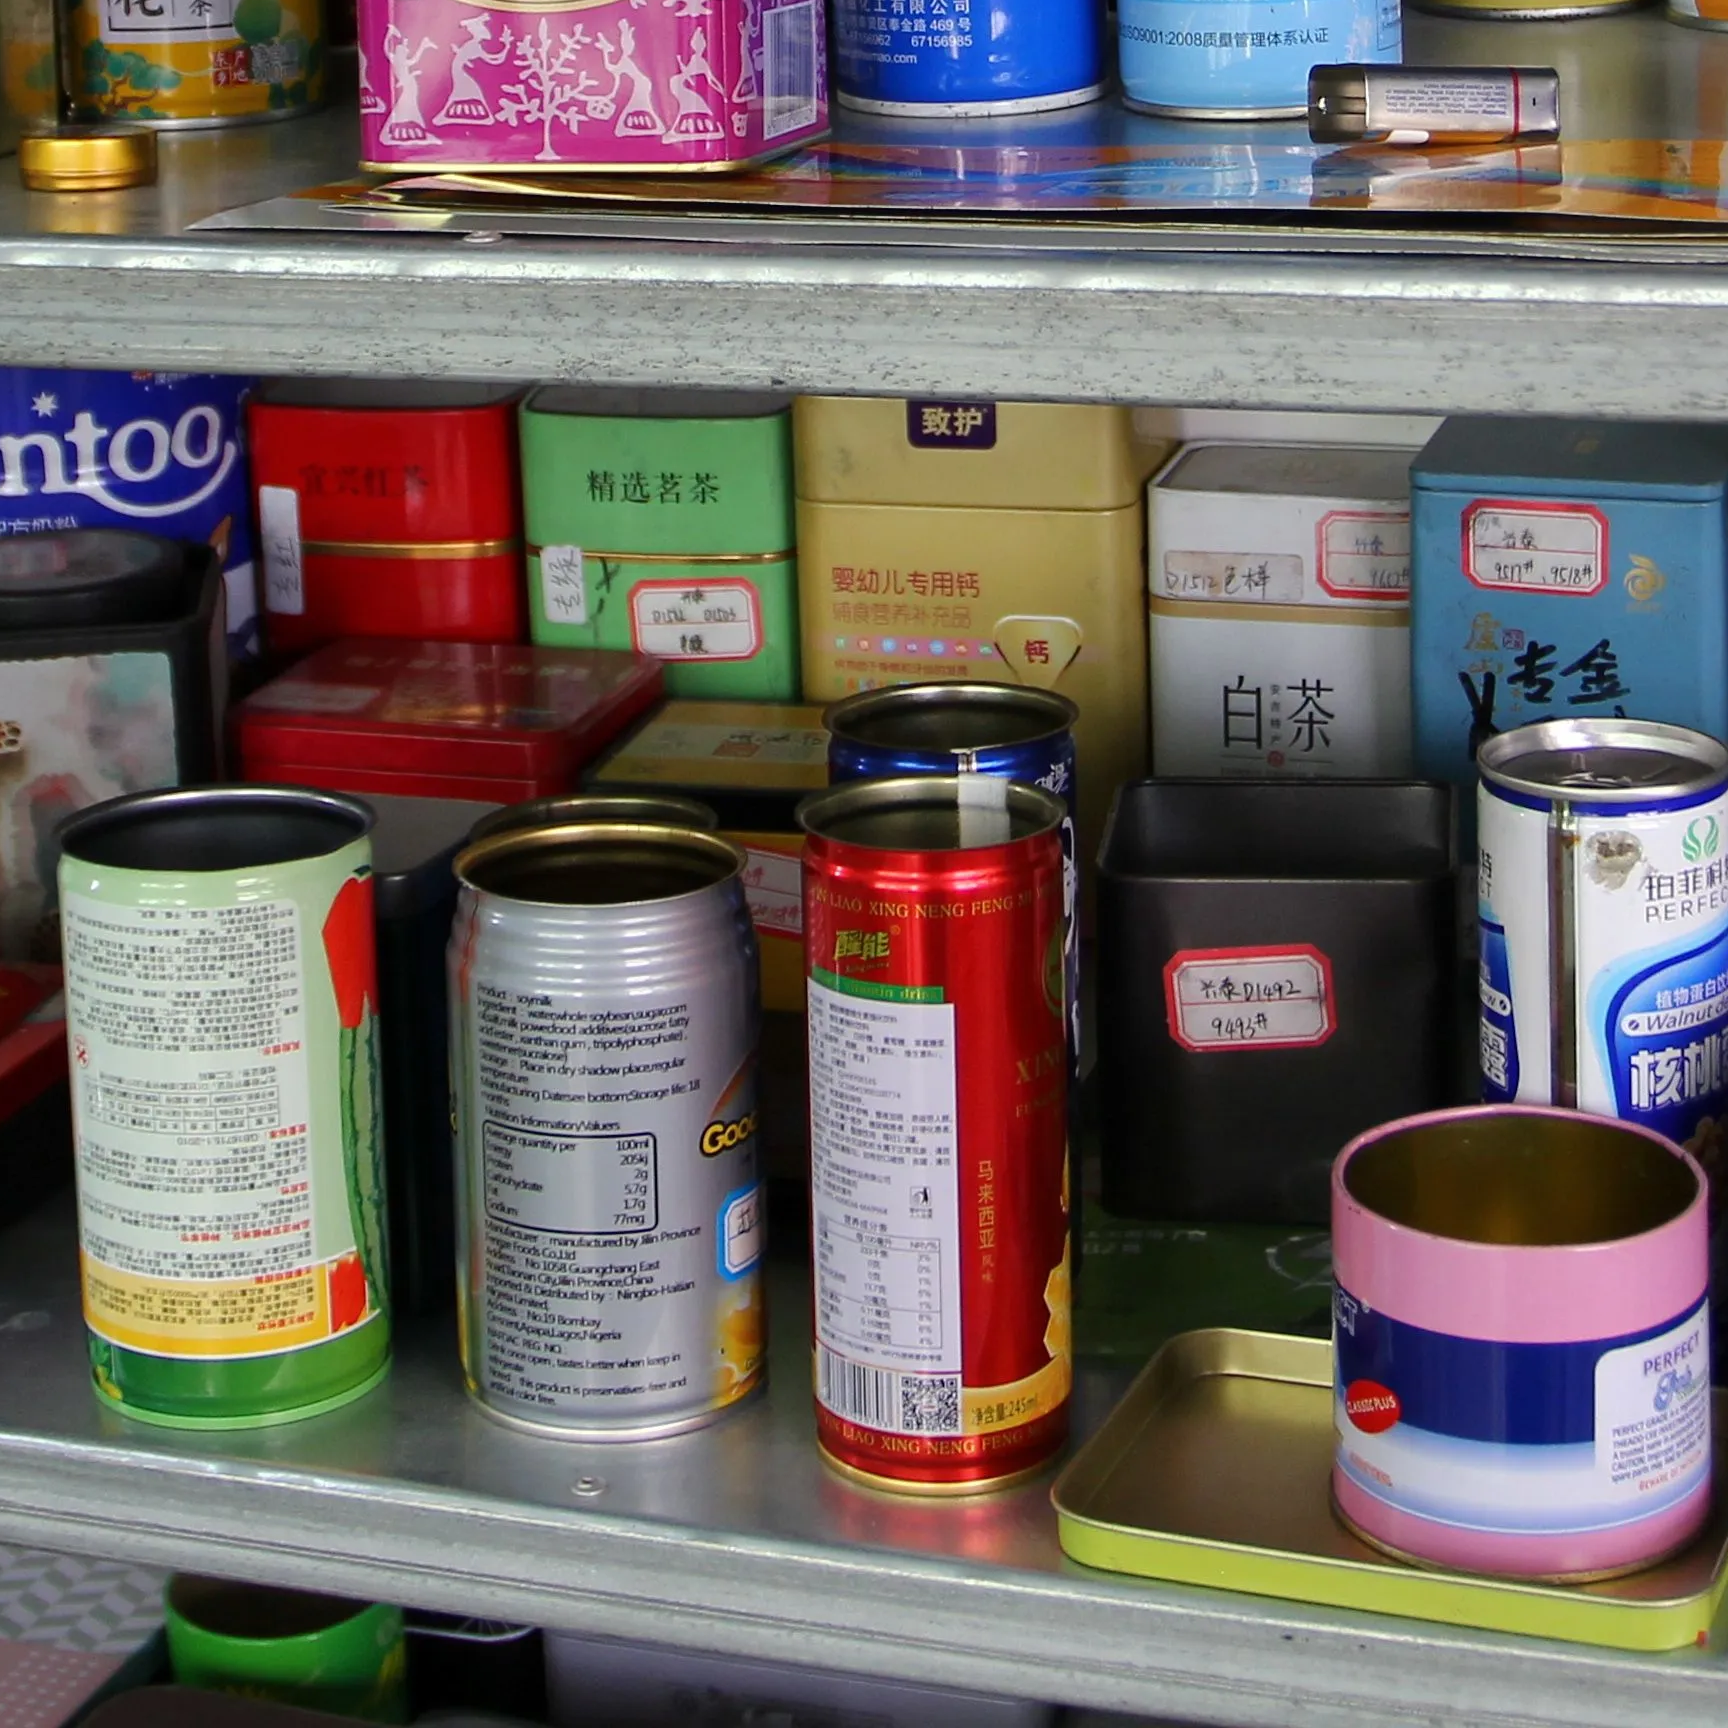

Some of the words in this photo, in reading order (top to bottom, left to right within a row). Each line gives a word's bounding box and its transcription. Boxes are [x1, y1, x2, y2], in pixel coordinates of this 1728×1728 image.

[920, 405, 986, 440] 致护
[585, 467, 722, 507] 精选茗茶
[831, 566, 981, 601] 婴幼儿专用钙
[832, 600, 974, 631] 辅食营养补充品
[1024, 638, 1050, 666] 钙
[1221, 673, 1336, 753] 白茶
[868, 898, 909, 919] XING
[914, 901, 965, 921] NENG
[970, 893, 1014, 917] FENG
[1645, 1005, 1713, 1033] Walnut
[977, 1159, 996, 1250] 马来西亚
[1642, 1328, 1701, 1378] PERFECT
[880, 1433, 921, 1455] XING
[926, 1436, 976, 1456] NENG
